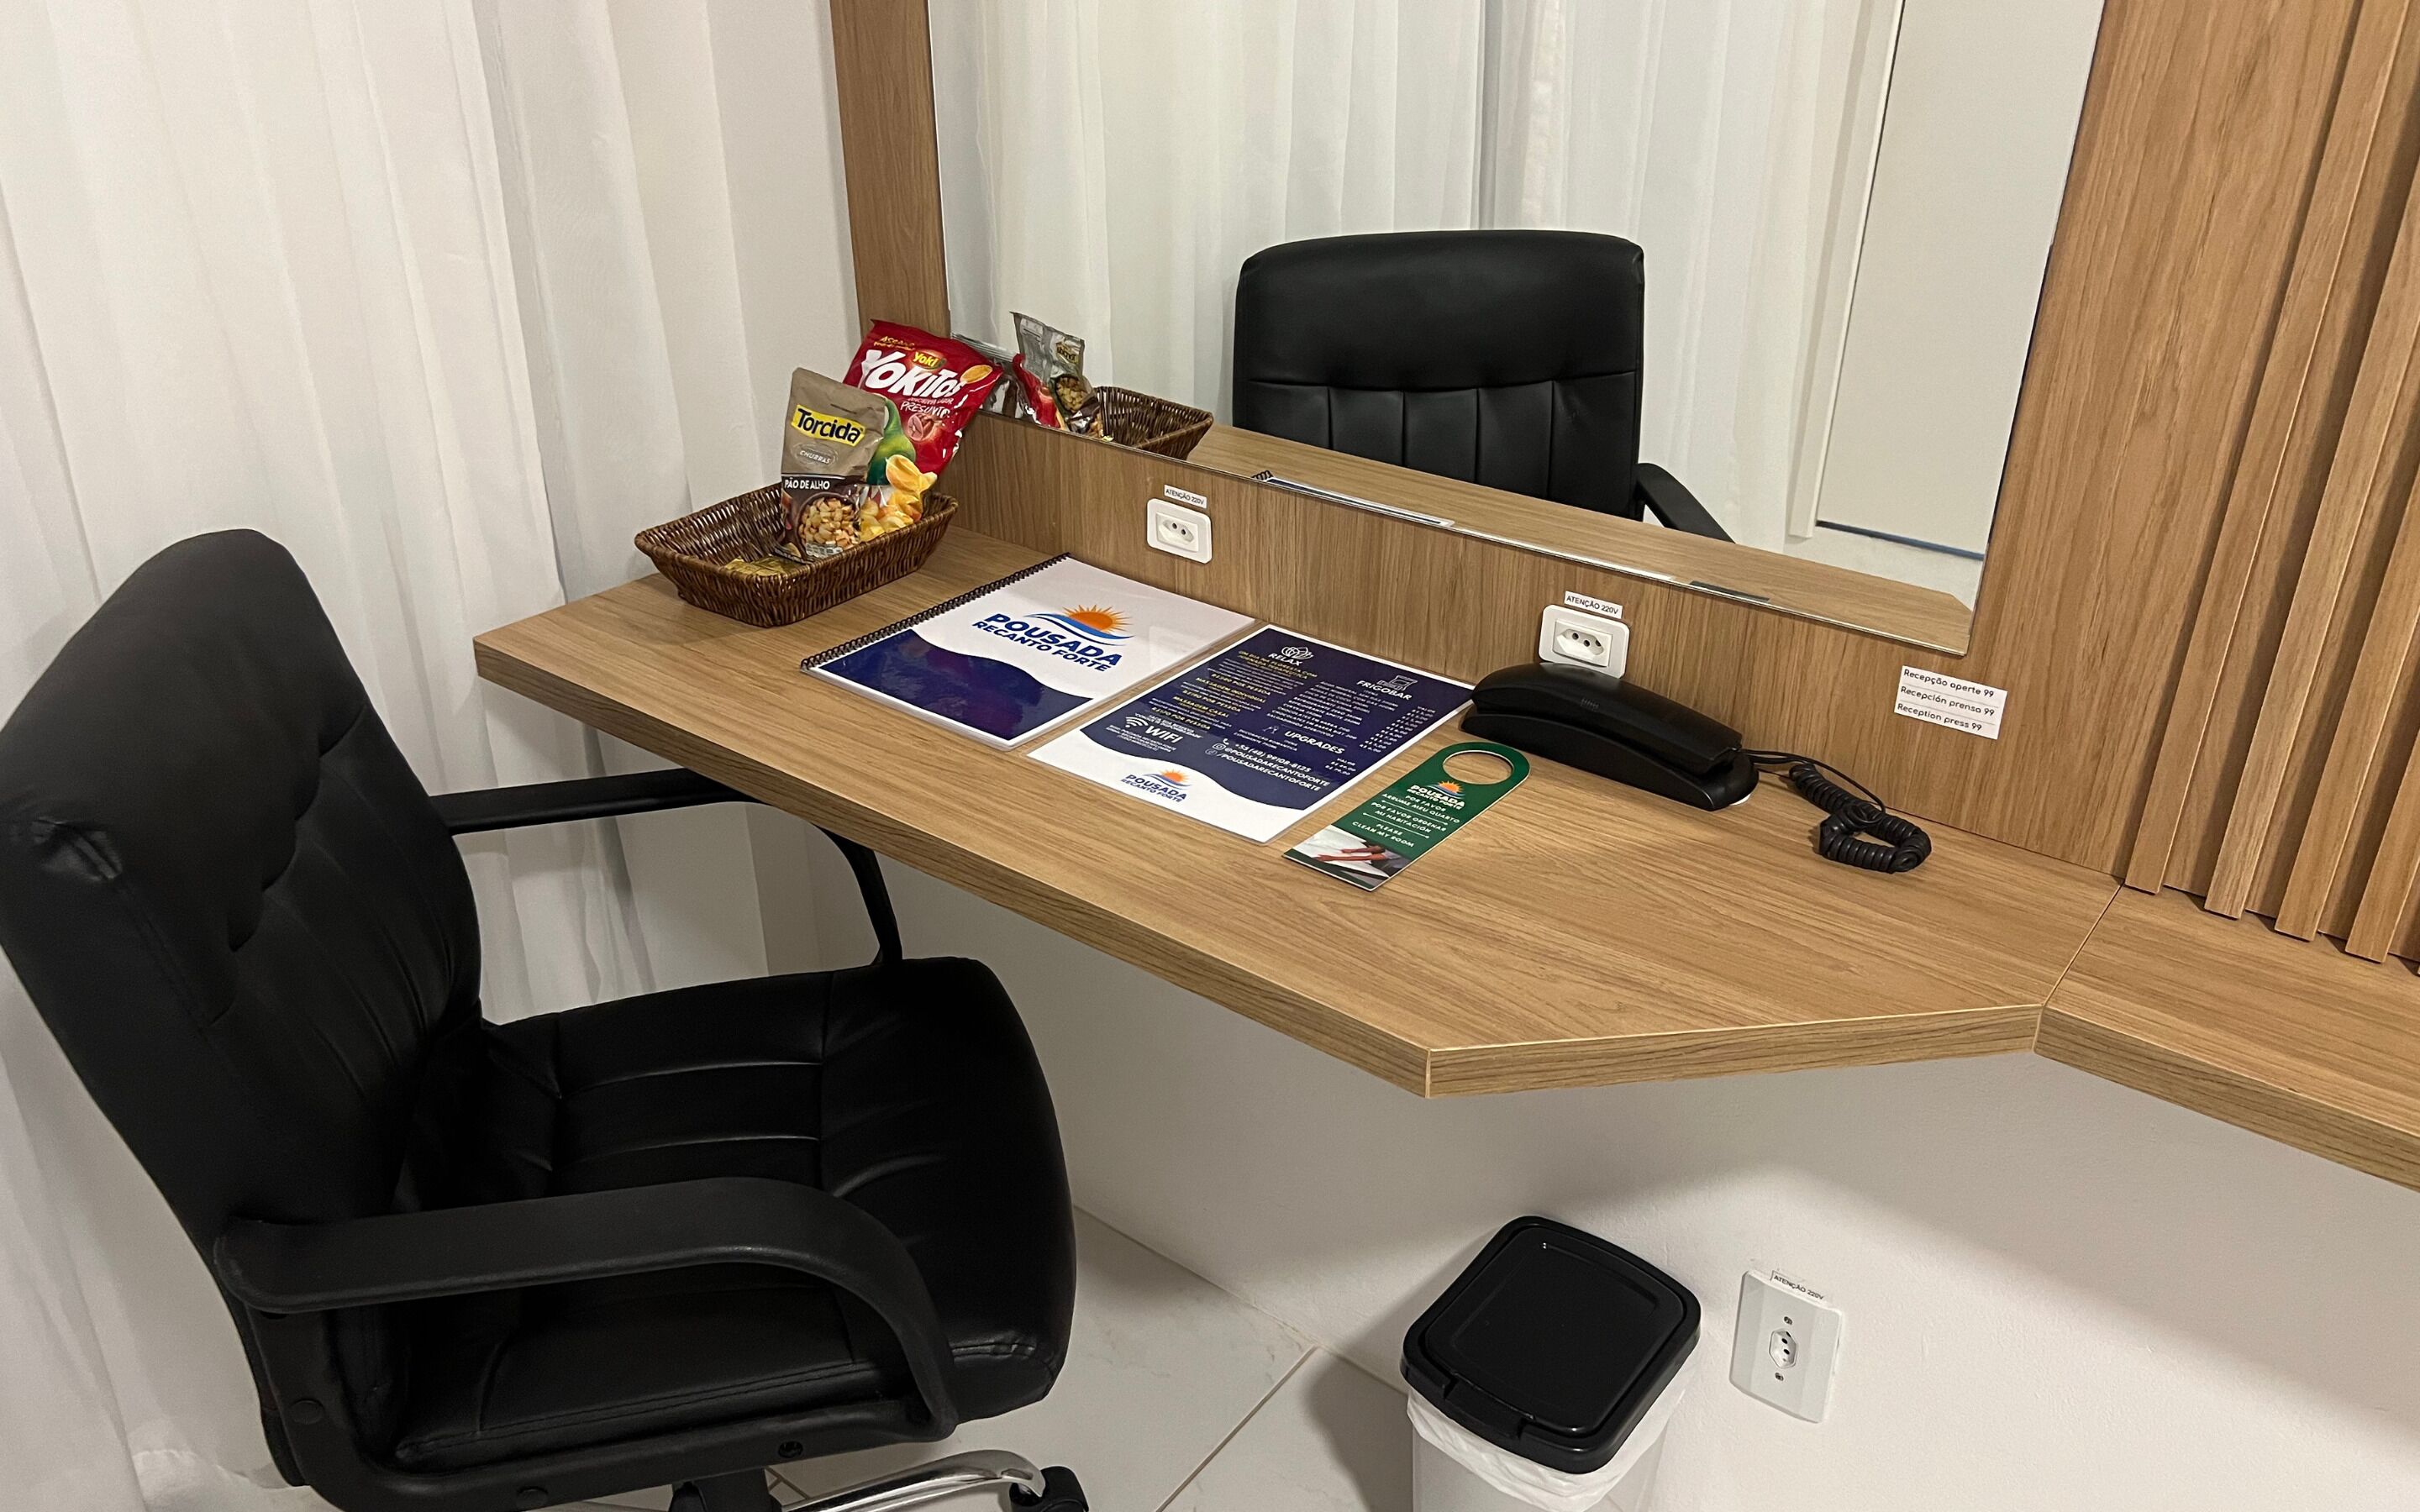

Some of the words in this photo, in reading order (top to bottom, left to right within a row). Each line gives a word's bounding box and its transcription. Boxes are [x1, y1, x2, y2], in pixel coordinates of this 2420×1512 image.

[798, 408, 861, 444] Torcida
[800, 450, 831, 464] CHURRAS
[784, 477, 799, 489] PÃO
[800, 480, 809, 489] DE
[810, 480, 830, 490] ALHO
[1166, 489, 1191, 501] ATENÇÃO
[1192, 496, 1204, 505] 220V
[1566, 596, 1600, 609] ATENÇÃO
[1602, 605, 1618, 614] 220V
[972, 621, 1052, 652] RECANTO
[1052, 649, 1112, 672] FORTE
[984, 613, 1123, 666] POUSADA
[1267, 653, 1303, 665] RELAX
[1355, 680, 1413, 700] FRIGOBAR
[1903, 669, 1948, 686] Recepção
[1949, 682, 1981, 695] aperte
[1984, 689, 1994, 698] 99
[1901, 685, 1947, 705] Recepción
[1949, 699, 1981, 713] prensa
[1984, 707, 1995, 717] 99
[1897, 703, 1942, 721] Reception
[1944, 716, 1970, 728] press
[1971, 722, 1982, 731] 99
[1140, 725, 1184, 743] WIFI
[1282, 731, 1346, 753] UPGRADES
[1246, 748, 1267, 757] (48)
[1119, 779, 1157, 793] RECANTO
[1155, 791, 1183, 802] FORTE
[1124, 774, 1190, 799] POUSADA
[1411, 785, 1465, 807] POUSADA
[1381, 793, 1411, 806] ARRUME
[1412, 804, 1428, 812] MEU
[1429, 811, 1460, 823] QUARTO
[1405, 795, 1419, 803] POR
[1420, 800, 1446, 812] FAVOR
[1376, 823, 1403, 836] PLEASE
[1386, 806, 1412, 820] FAVOR
[1412, 816, 1447, 832] ORDENAR
[1386, 814, 1432, 833] HABITACIÓN
[1352, 821, 1376, 833] CLEAN
[1390, 835, 1414, 848] ROOM
[1774, 1275, 1806, 1292] ATENÇÃO
[1807, 1289, 1824, 1300] 220V
